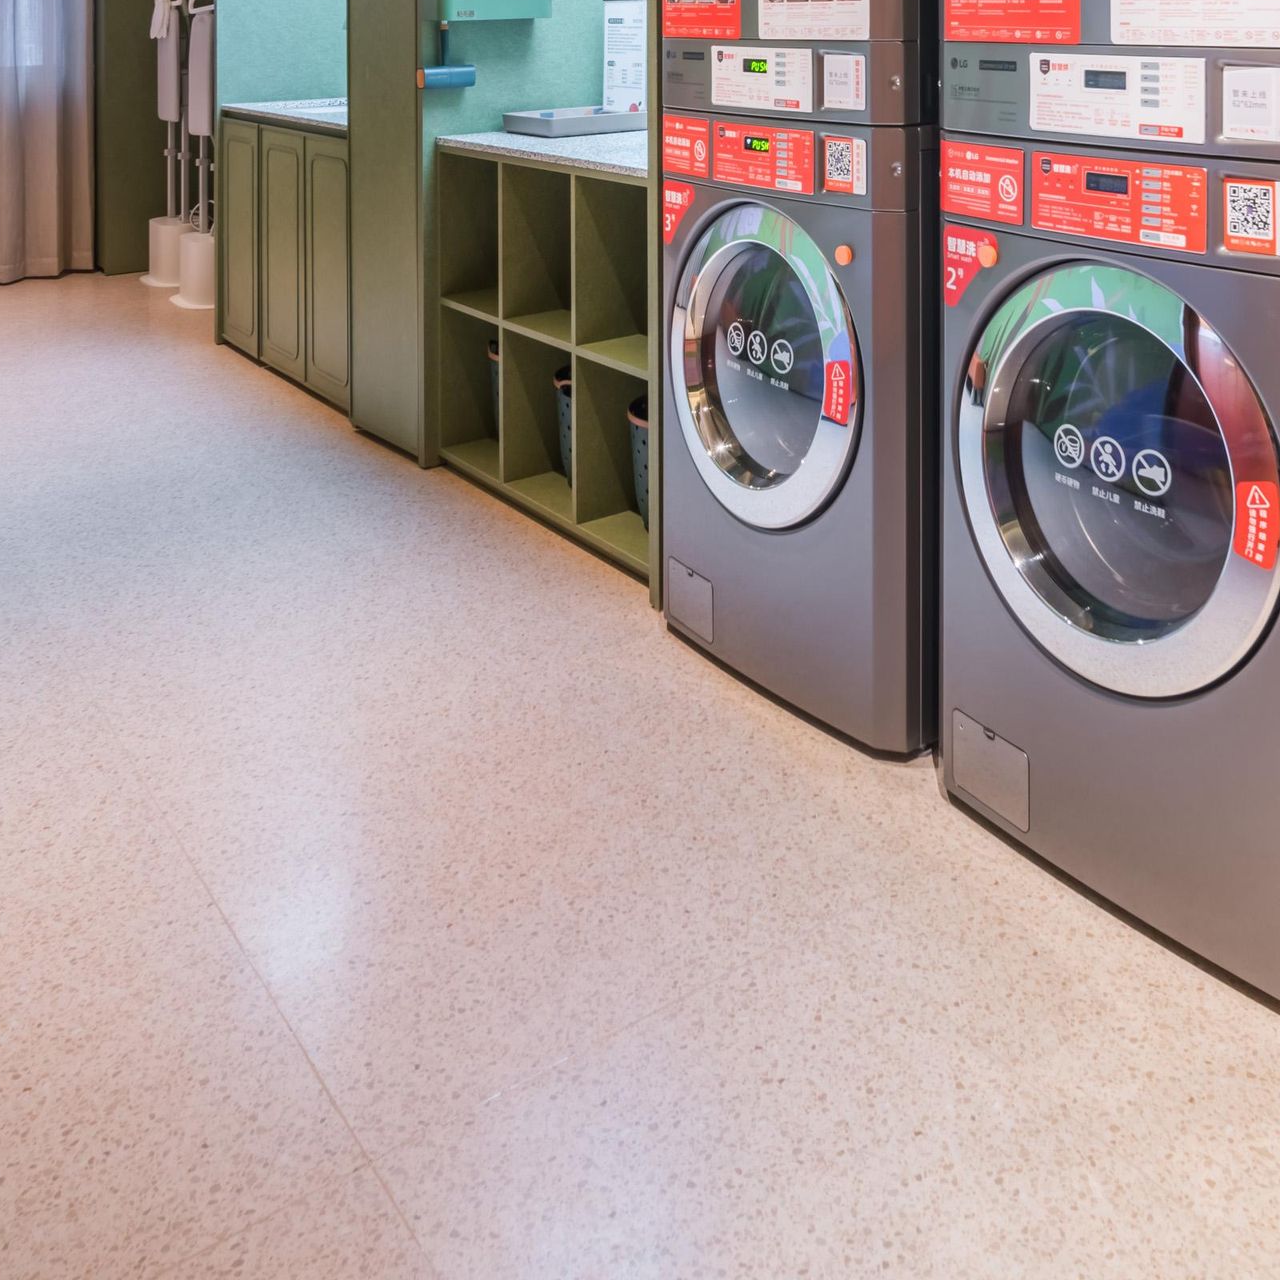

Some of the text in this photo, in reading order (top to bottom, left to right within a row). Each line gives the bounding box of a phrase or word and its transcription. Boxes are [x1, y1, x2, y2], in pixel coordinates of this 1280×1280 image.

[947, 167, 991, 184] 本机自动添加
[947, 236, 977, 257] 智慧洗
[1091, 486, 1120, 504] 禁止儿童
[1133, 500, 1166, 519] 禁止洗鞋
